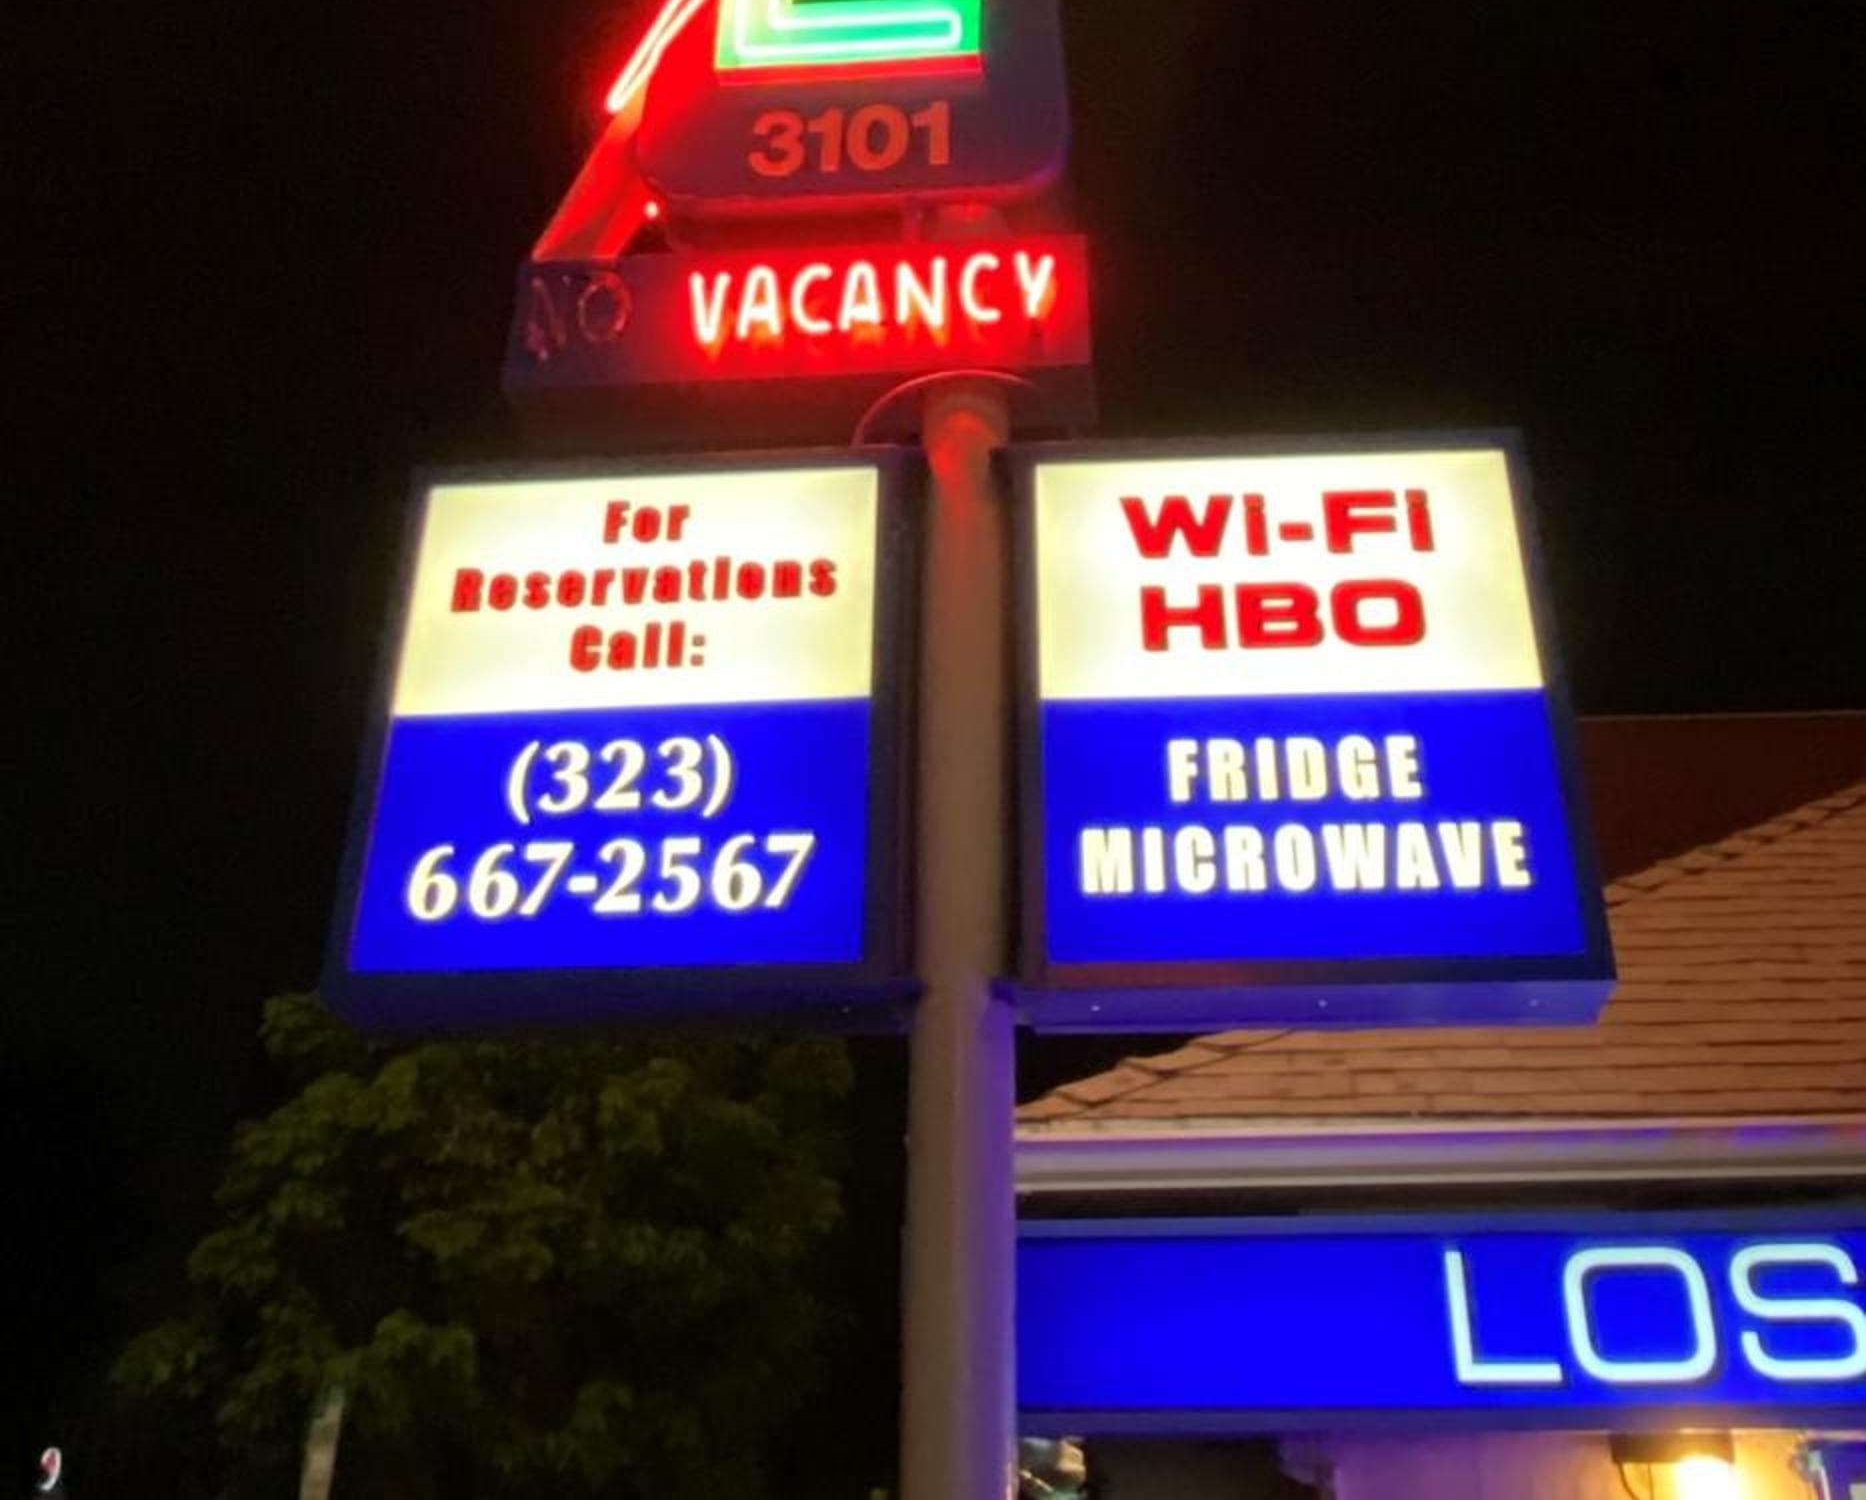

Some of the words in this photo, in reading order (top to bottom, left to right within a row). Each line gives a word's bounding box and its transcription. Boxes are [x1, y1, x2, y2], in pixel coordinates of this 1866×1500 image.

[747, 102, 951, 177] 3101
[688, 251, 1055, 345] VACANCY
[603, 501, 690, 543] For
[450, 558, 838, 612] Reservations
[1140, 579, 1427, 652] HBO
[569, 621, 706, 672] Call:
[507, 734, 732, 824] (323)
[1167, 735, 1424, 803] FRIDGE
[406, 833, 815, 921] 667-2567
[1080, 821, 1532, 896] MICROWAVE
[1444, 1243, 1866, 1384] LOS
